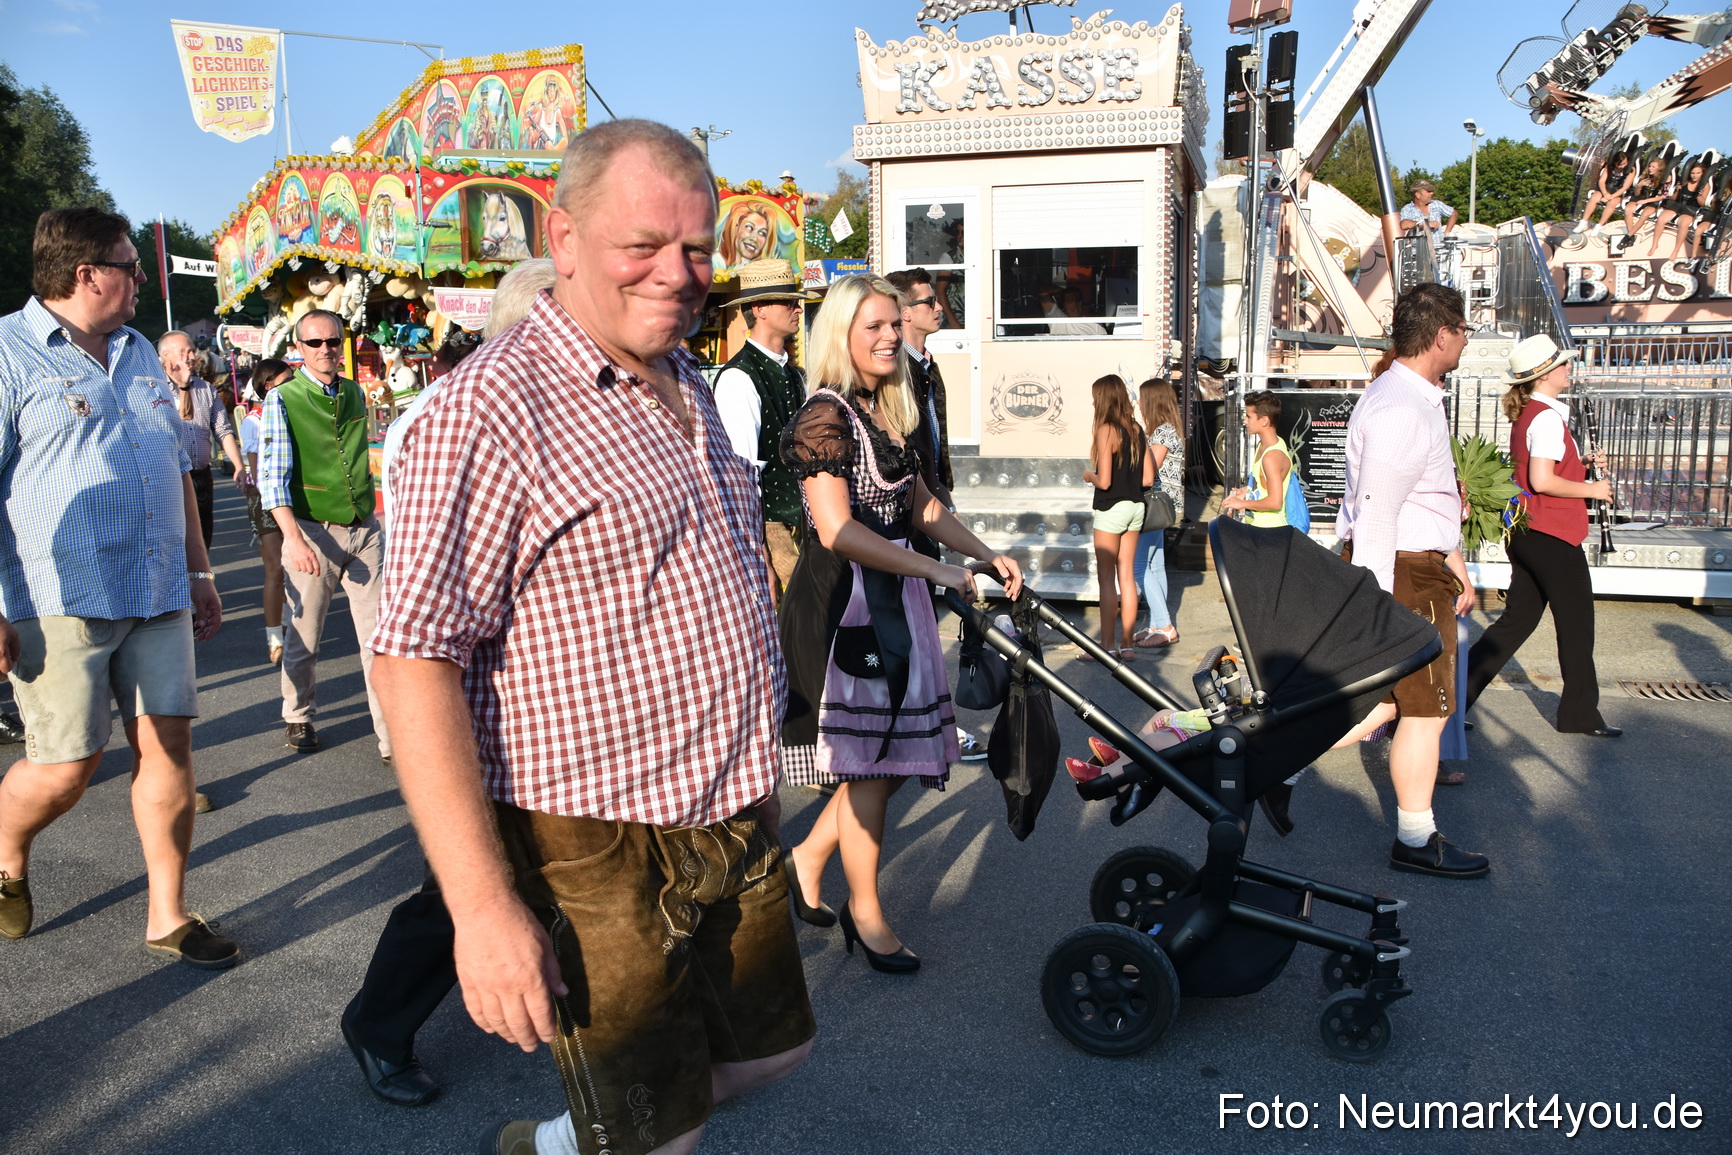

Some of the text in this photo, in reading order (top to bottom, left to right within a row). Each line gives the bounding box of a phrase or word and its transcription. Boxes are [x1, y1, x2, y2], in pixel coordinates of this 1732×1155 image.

[185, 36, 203, 47] STOP
[214, 35, 243, 52] DAS
[192, 55, 270, 72] GESCHICK-
[192, 76, 274, 93] LICHKEITS-
[894, 47, 1142, 113] KASSE
[216, 95, 257, 112] SPIEL
[184, 261, 201, 272] Auf
[438, 293, 464, 313] Knack
[466, 300, 477, 313] den
[1017, 385, 1038, 394] DER
[1006, 392, 1049, 408] BURNER
